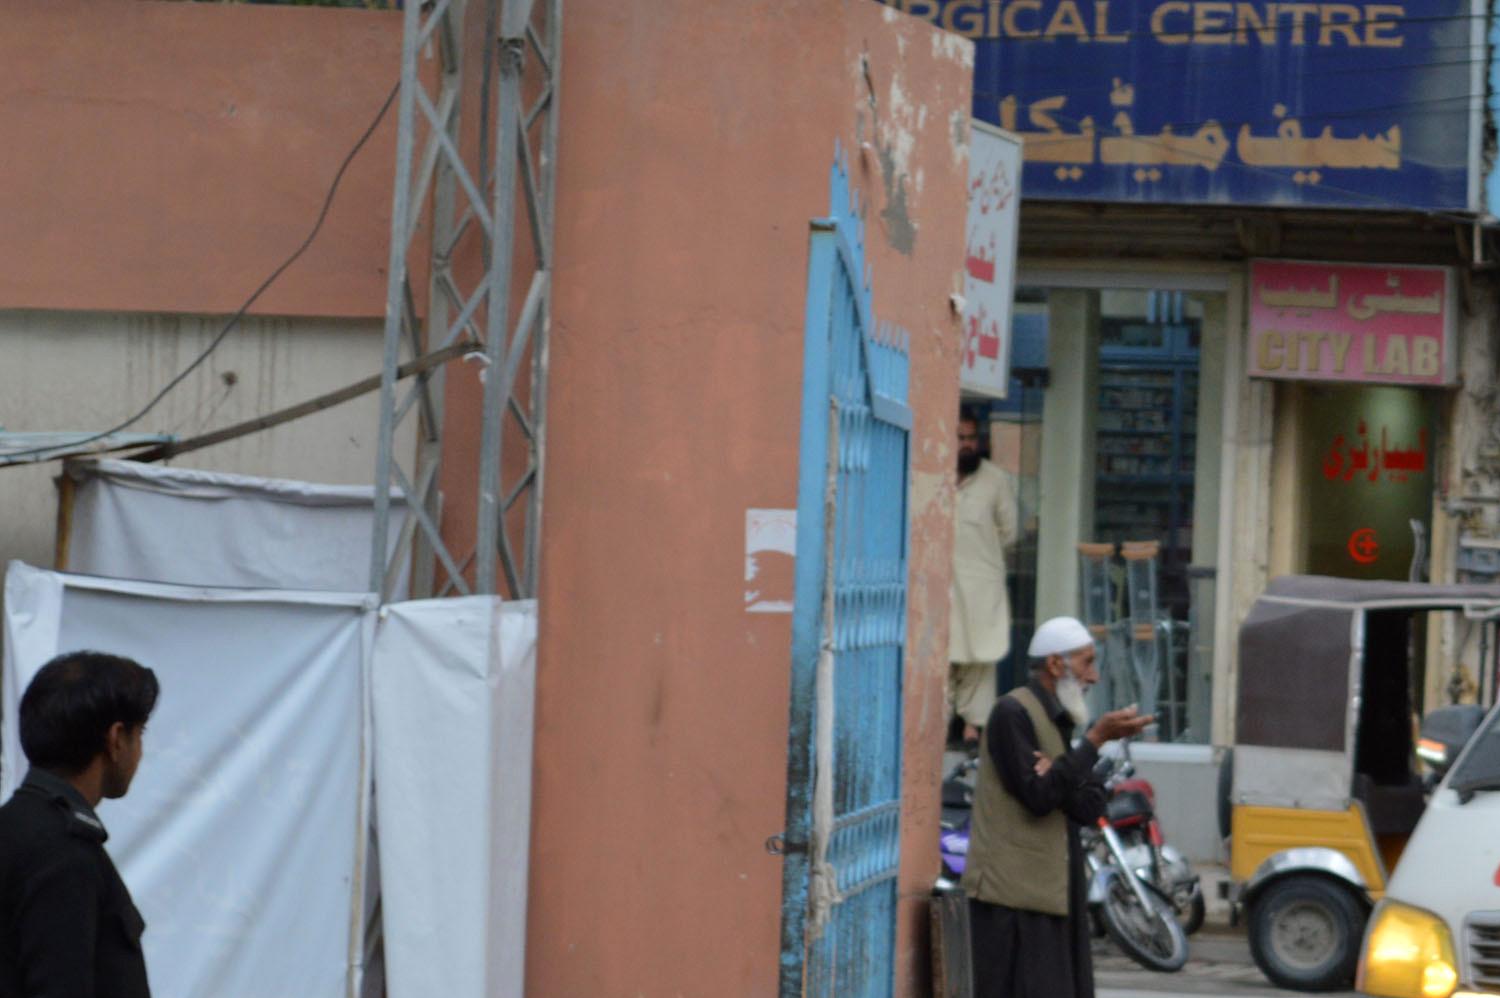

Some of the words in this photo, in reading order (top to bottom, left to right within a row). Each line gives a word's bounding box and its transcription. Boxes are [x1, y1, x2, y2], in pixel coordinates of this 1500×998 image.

[1151, 0, 1405, 47] CENTRE
[1257, 329, 1354, 374] CITY
[1363, 334, 1441, 377] LAB
